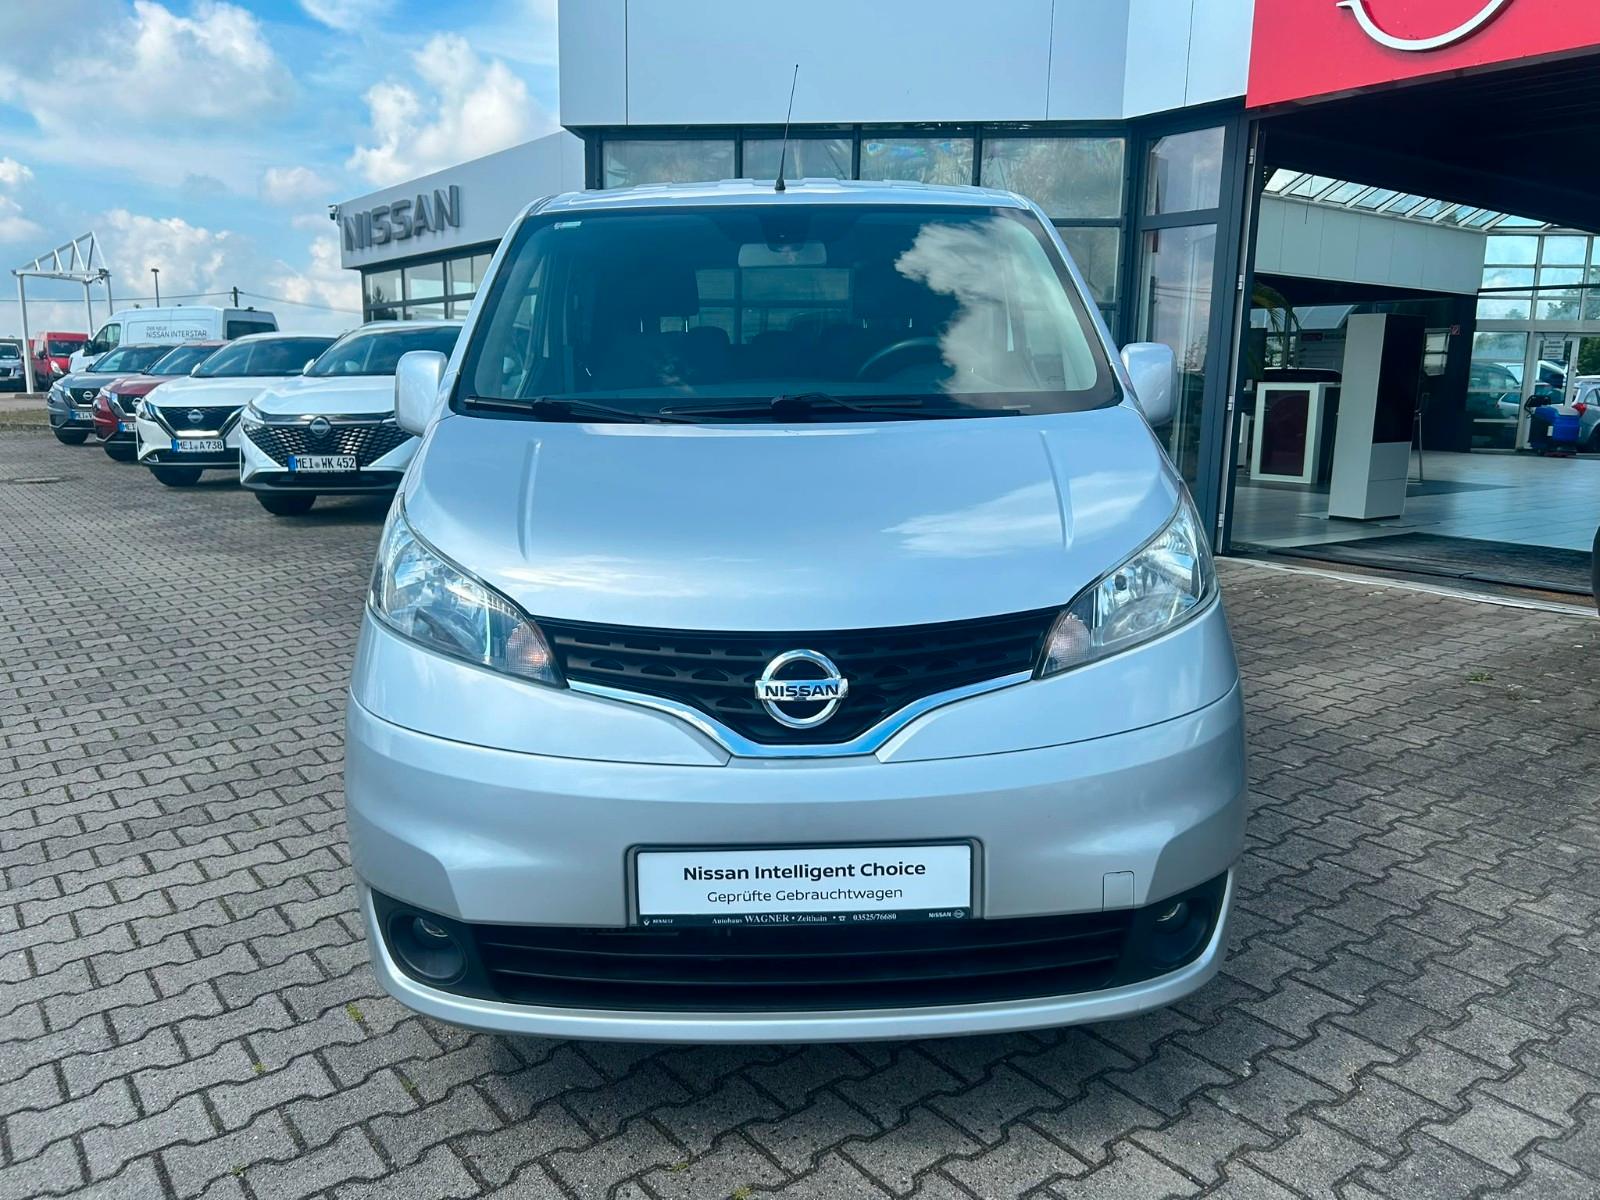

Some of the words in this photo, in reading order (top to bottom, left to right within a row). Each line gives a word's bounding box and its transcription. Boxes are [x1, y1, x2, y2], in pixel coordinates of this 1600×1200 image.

[344, 185, 459, 252] NISSAN
[145, 330, 170, 338] NISSAN
[171, 329, 207, 337] INTERSTAR
[295, 457, 314, 469] MEI
[321, 457, 334, 469] WK
[337, 457, 355, 468] 452
[765, 684, 839, 697] NISSAN
[683, 866, 749, 880] Nissan
[755, 864, 855, 881] Intelligent
[860, 861, 926, 877] Choice
[707, 890, 772, 905] Geprüfte
[776, 888, 903, 902] Gebrauchtwagen
[744, 914, 789, 923] WAGNER
[797, 914, 827, 922] Zeithain
